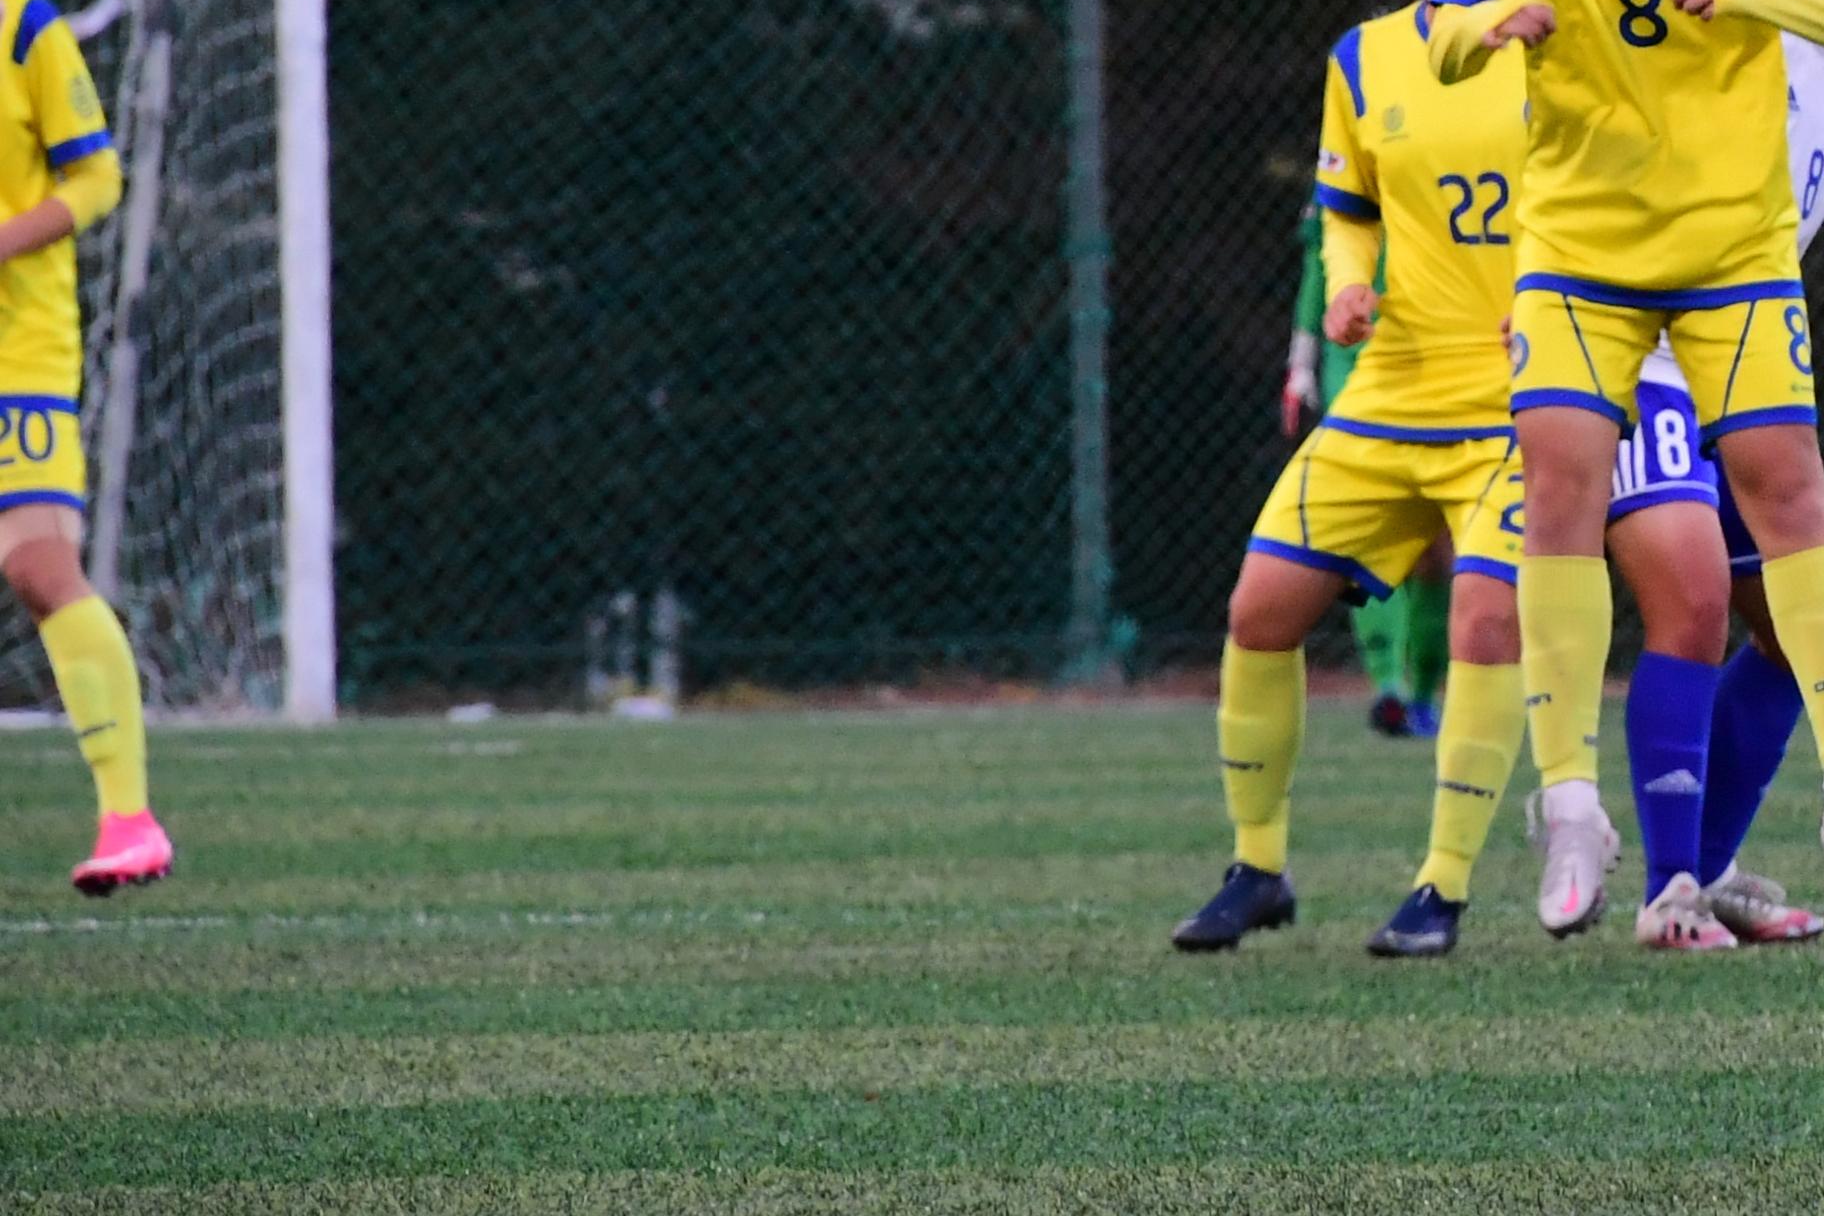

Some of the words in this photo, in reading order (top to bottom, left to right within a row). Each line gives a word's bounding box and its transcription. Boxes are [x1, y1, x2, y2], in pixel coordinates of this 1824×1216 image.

[1438, 172, 1511, 244] 22
[1802, 149, 1824, 220] 8
[1784, 305, 1813, 375] 8
[1653, 408, 1692, 478] 8
